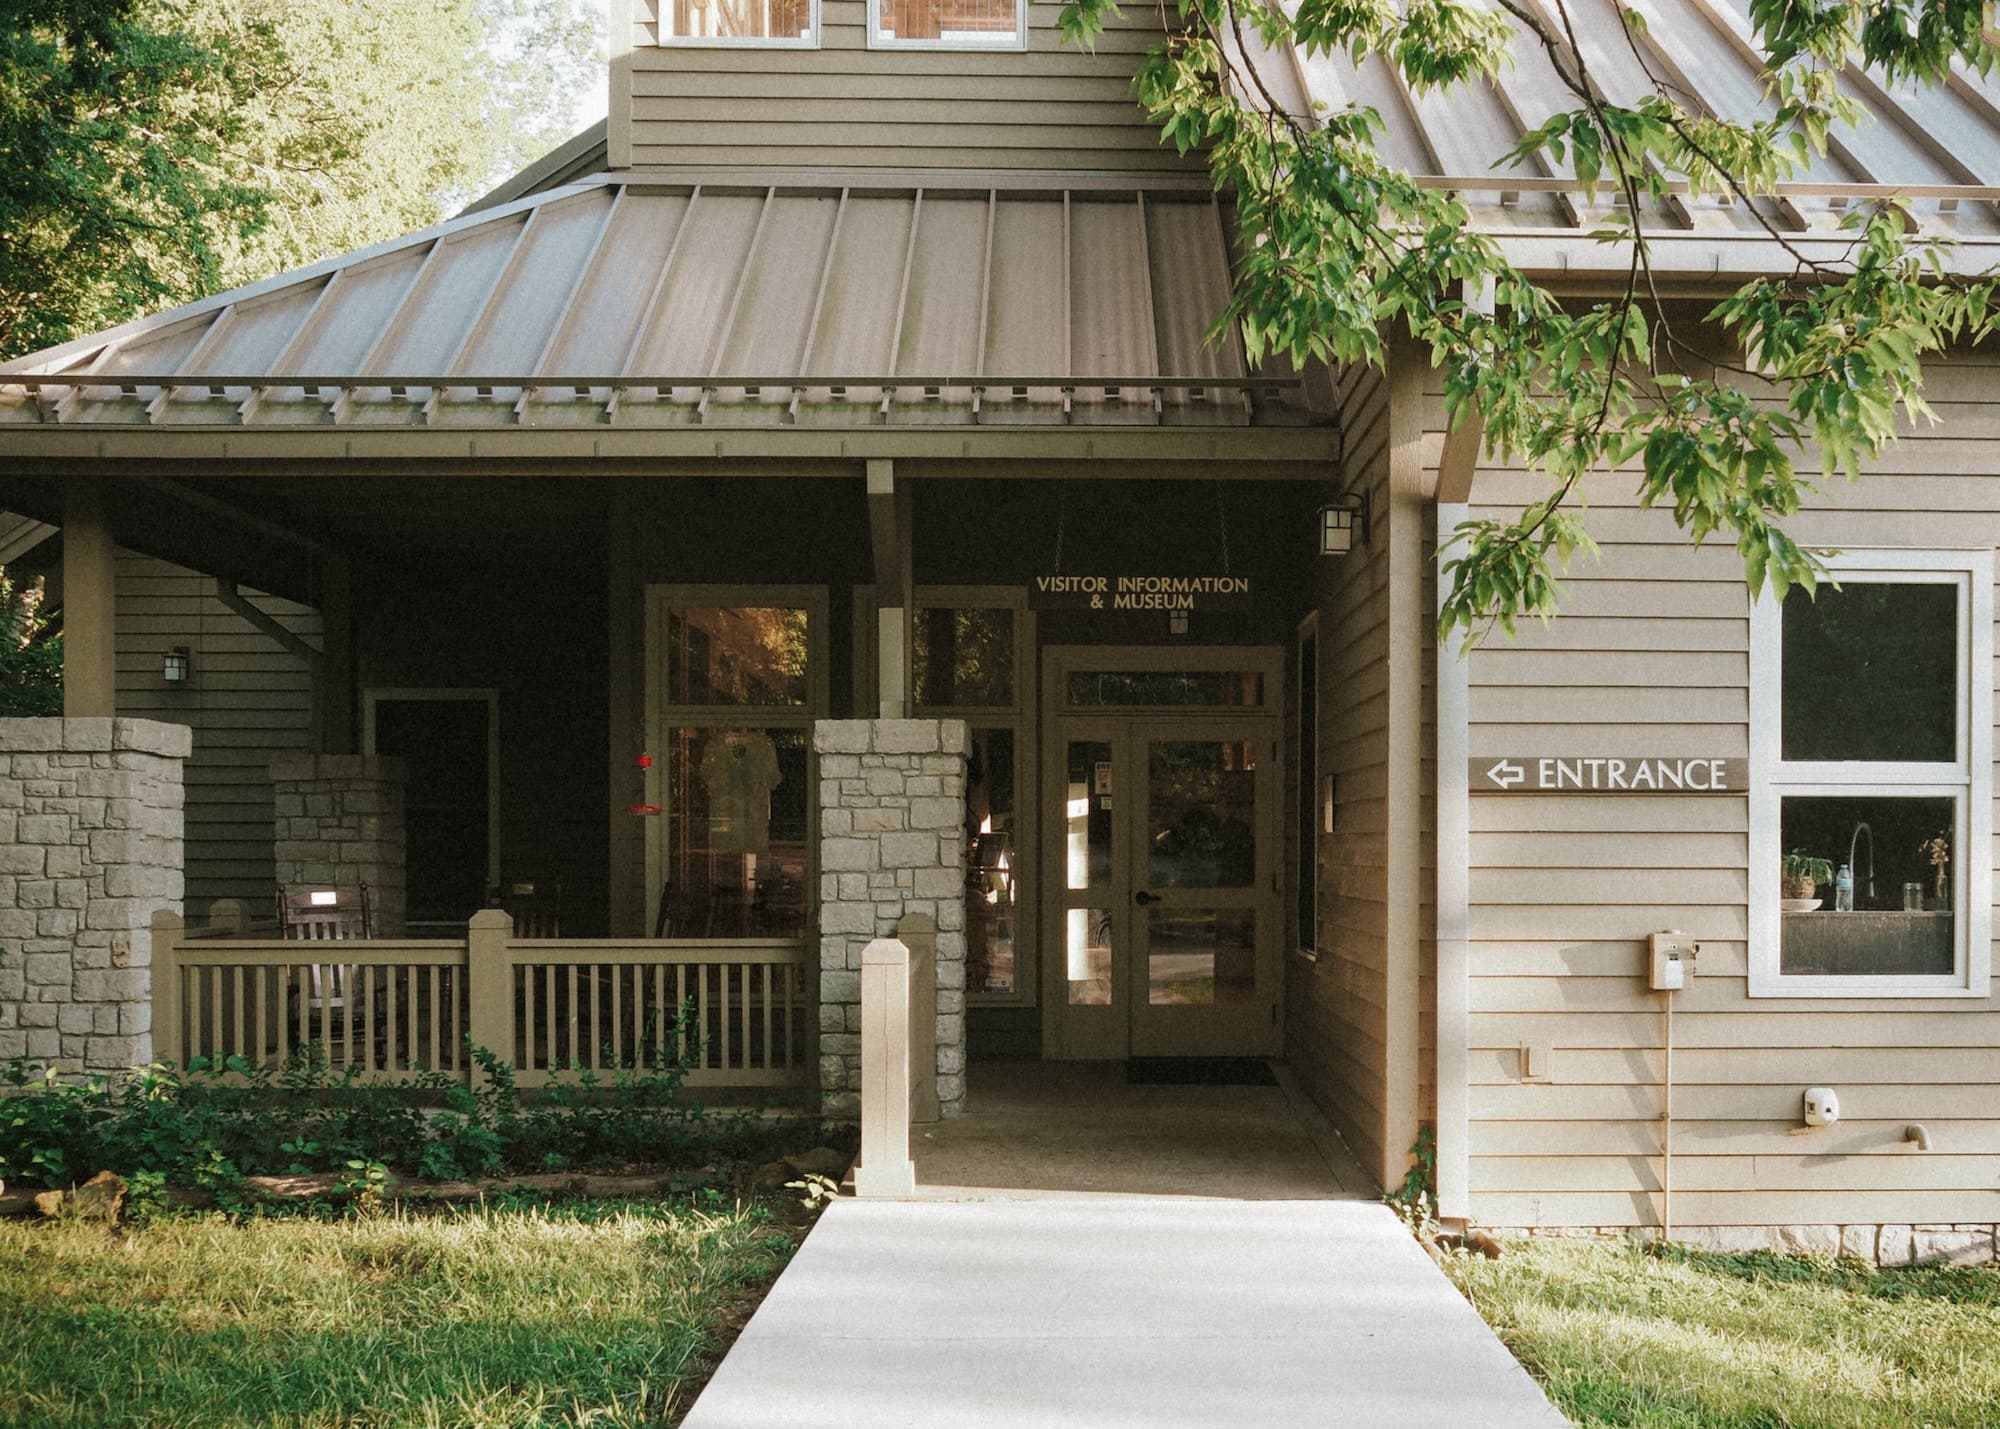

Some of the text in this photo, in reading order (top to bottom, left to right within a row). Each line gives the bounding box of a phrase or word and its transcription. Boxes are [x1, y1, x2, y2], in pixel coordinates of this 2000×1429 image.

[1036, 576, 1249, 593] VISITOR INFORMATION
[1090, 594, 1195, 609] & MUSEUM
[1538, 758, 1728, 790] ENTRANCE
